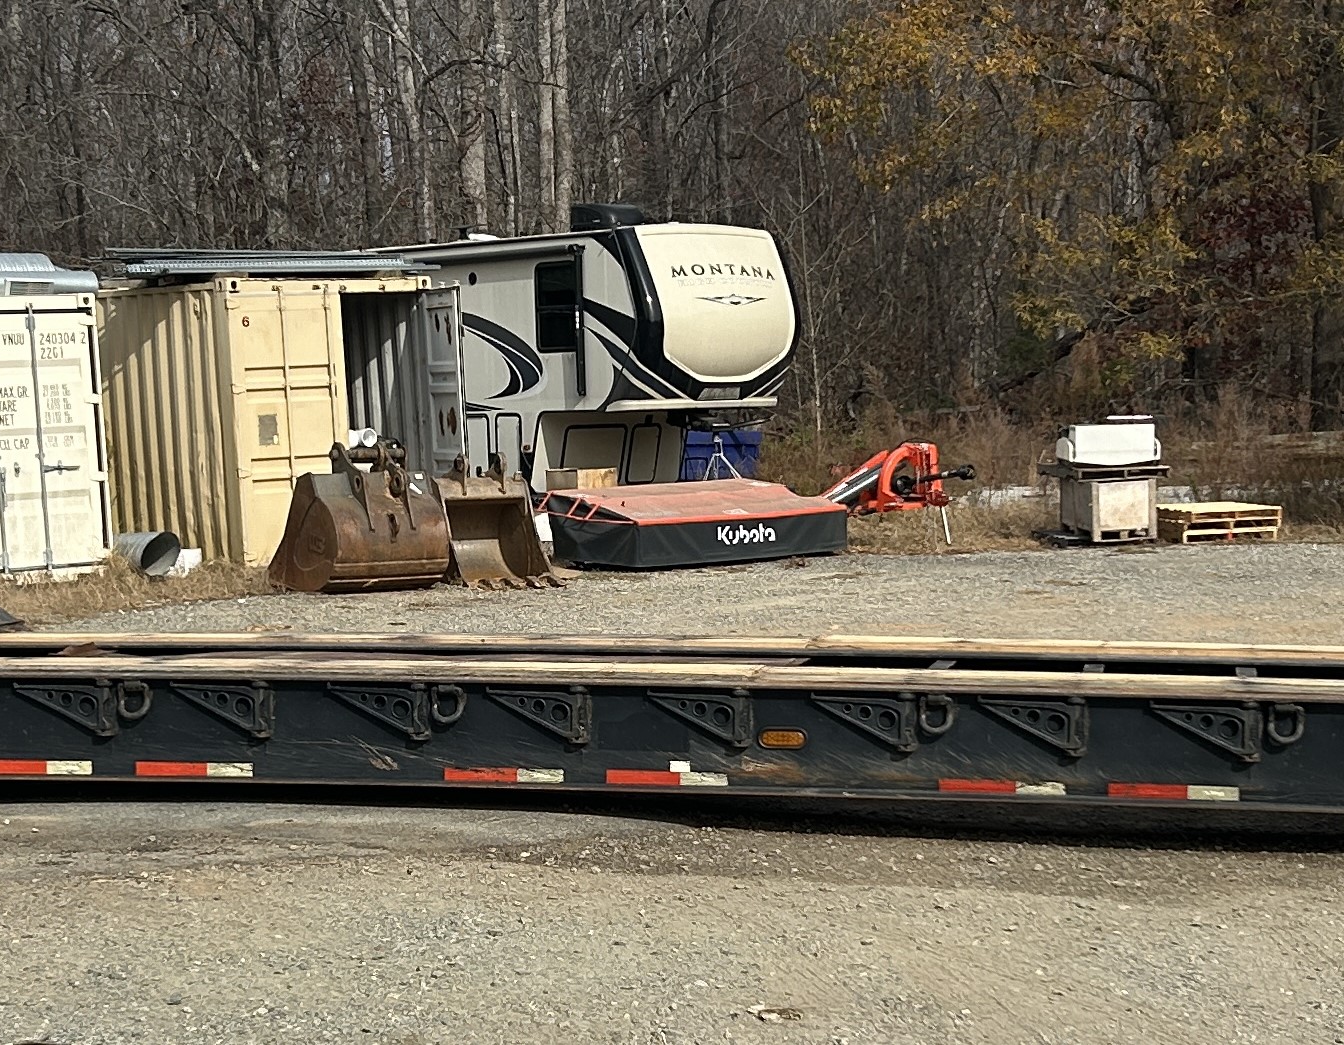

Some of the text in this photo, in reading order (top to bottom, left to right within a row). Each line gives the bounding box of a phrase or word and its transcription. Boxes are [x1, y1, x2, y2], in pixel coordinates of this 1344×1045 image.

[671, 264, 775, 280] MONTANA
[242, 316, 250, 327] 6
[39, 332, 76, 345] 240304
[80, 331, 87, 344] 2
[0, 414, 14, 426] NET
[717, 522, 776, 545] Kubota
